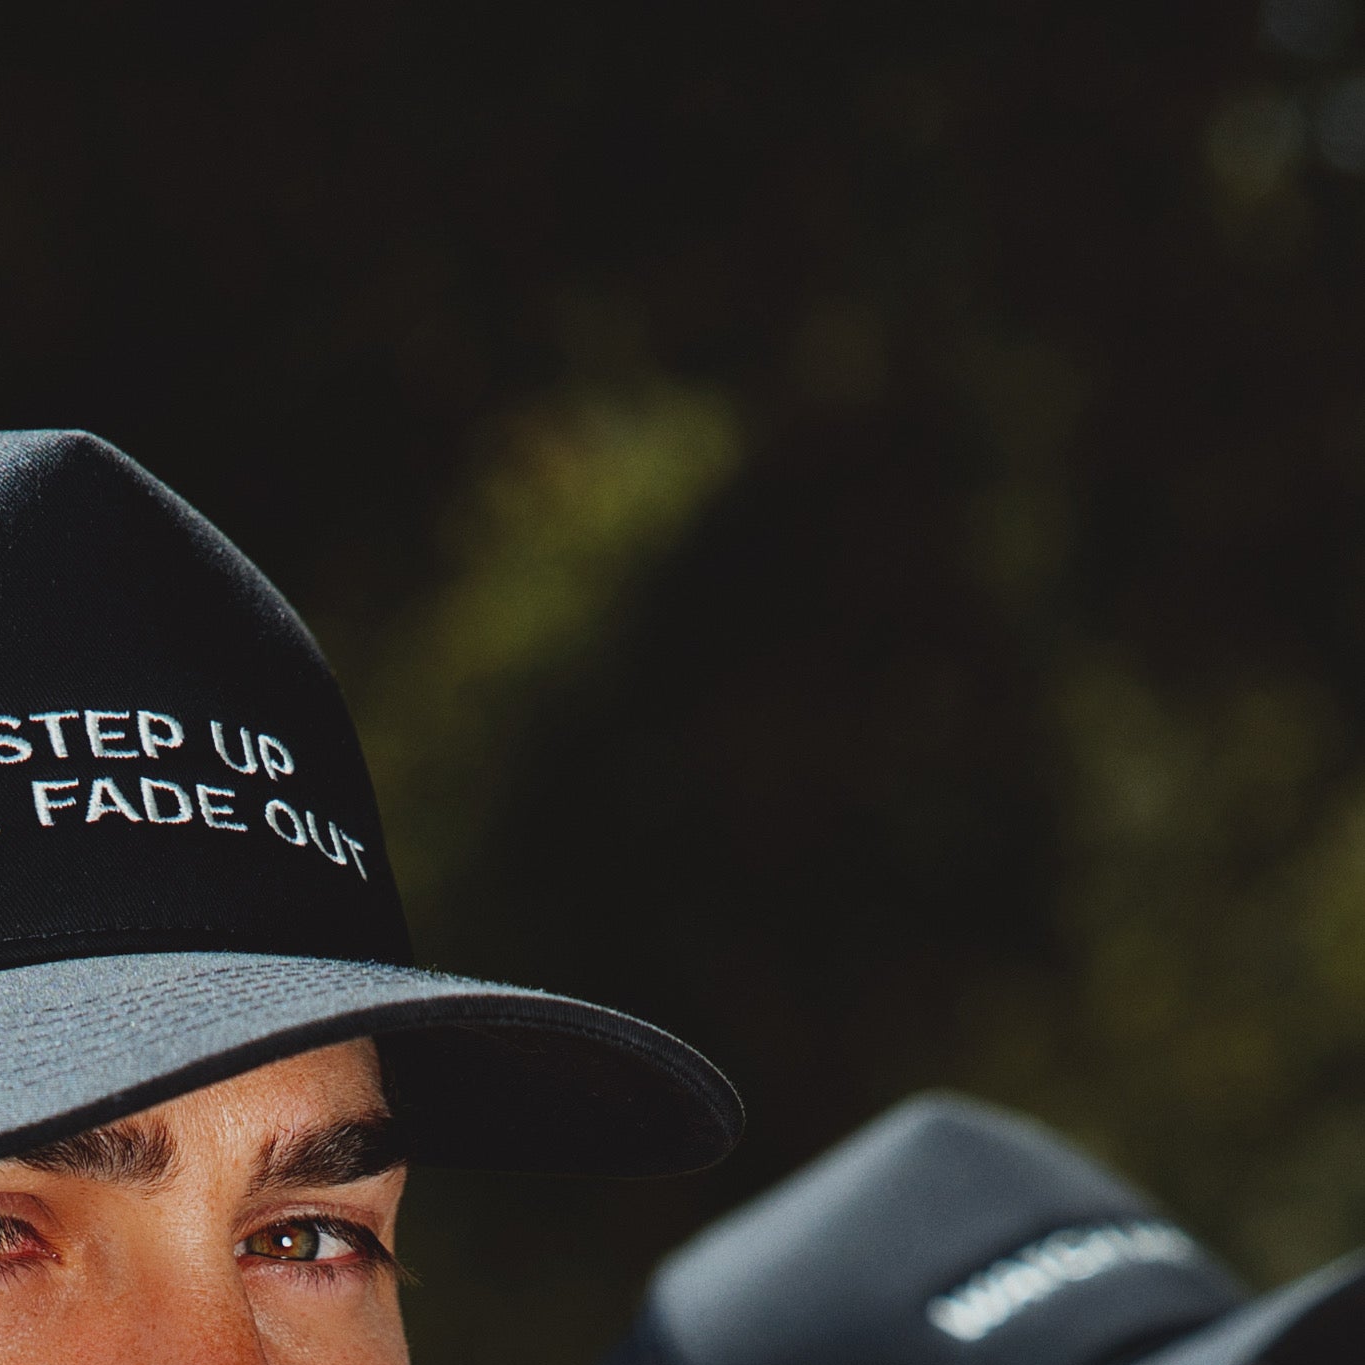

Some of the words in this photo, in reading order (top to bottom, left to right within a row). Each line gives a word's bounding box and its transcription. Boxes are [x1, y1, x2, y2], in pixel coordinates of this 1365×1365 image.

[210, 720, 295, 782] UP
[31, 777, 248, 833] FADE
[264, 798, 368, 882] OUT
